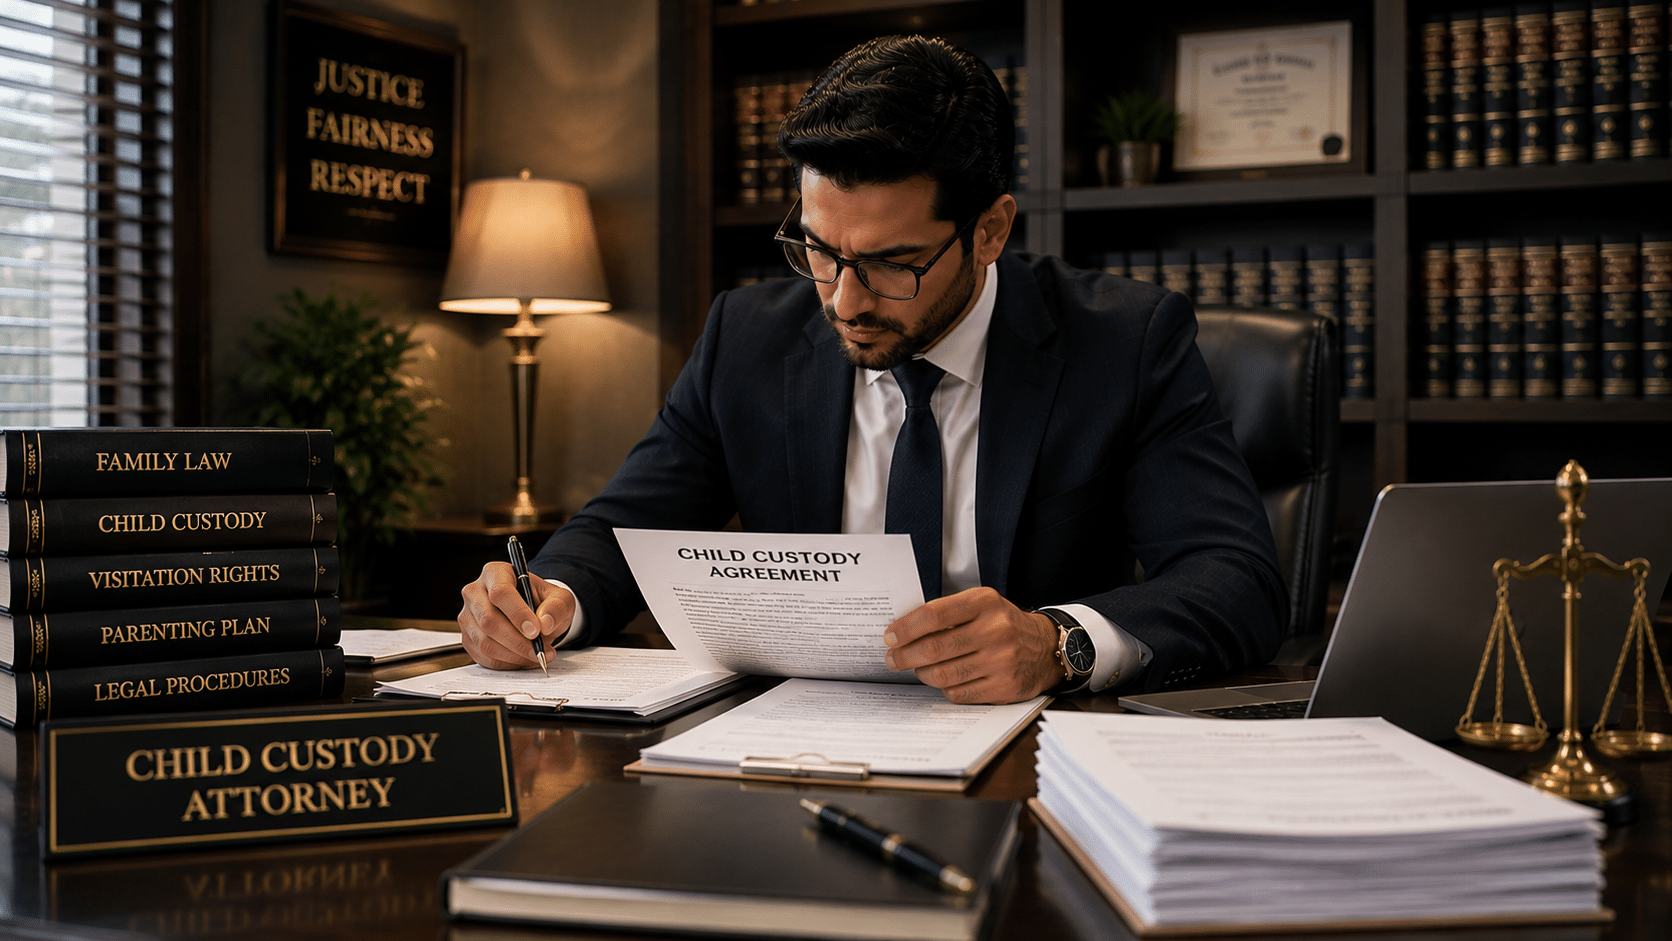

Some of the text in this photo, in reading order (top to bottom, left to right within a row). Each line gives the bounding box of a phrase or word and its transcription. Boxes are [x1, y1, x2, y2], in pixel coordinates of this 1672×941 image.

[314, 58, 425, 108] JUSTICE
[306, 107, 434, 158] FAIRNESS
[310, 158, 430, 204] RESPECT
[96, 452, 232, 472] FAMILY LAW
[98, 511, 267, 533] CHILD CUSTODY
[677, 547, 862, 566] CHILD CUSTODY
[88, 564, 280, 590] VISITATION RIGHTS
[709, 565, 842, 583] AGREEMENT
[100, 616, 271, 645] PARENTING PLAN
[94, 667, 291, 702] LEGAL PROCEDURES
[126, 733, 439, 780] CHILD CUSTODY
[182, 778, 396, 821] ATTORNEY
